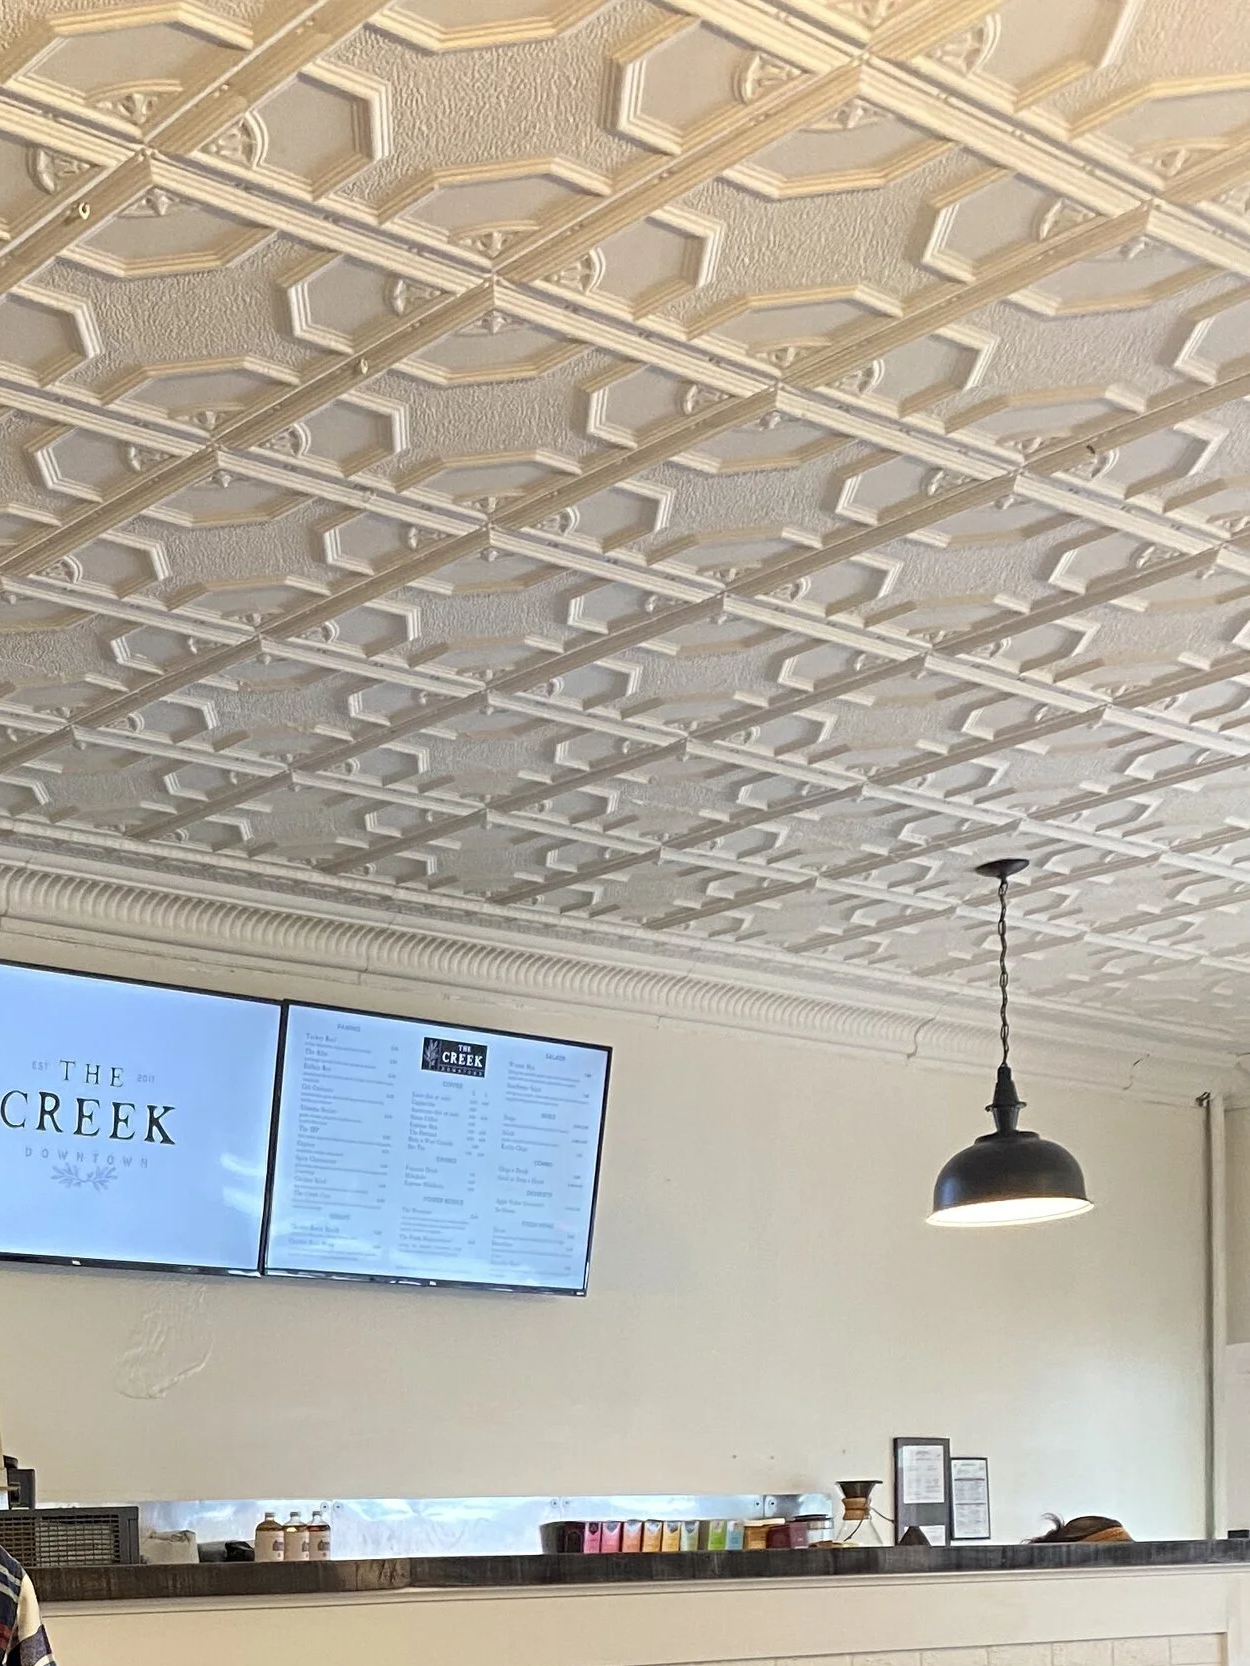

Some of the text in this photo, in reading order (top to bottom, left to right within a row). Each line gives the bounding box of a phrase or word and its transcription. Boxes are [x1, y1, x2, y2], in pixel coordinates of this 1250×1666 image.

[442, 1051, 483, 1068] CREEK
[458, 1044, 472, 1053] THE
[59, 1059, 125, 1088] THE
[0, 1090, 176, 1145] CREEK
[25, 1147, 148, 1169] DOWNTOWN
